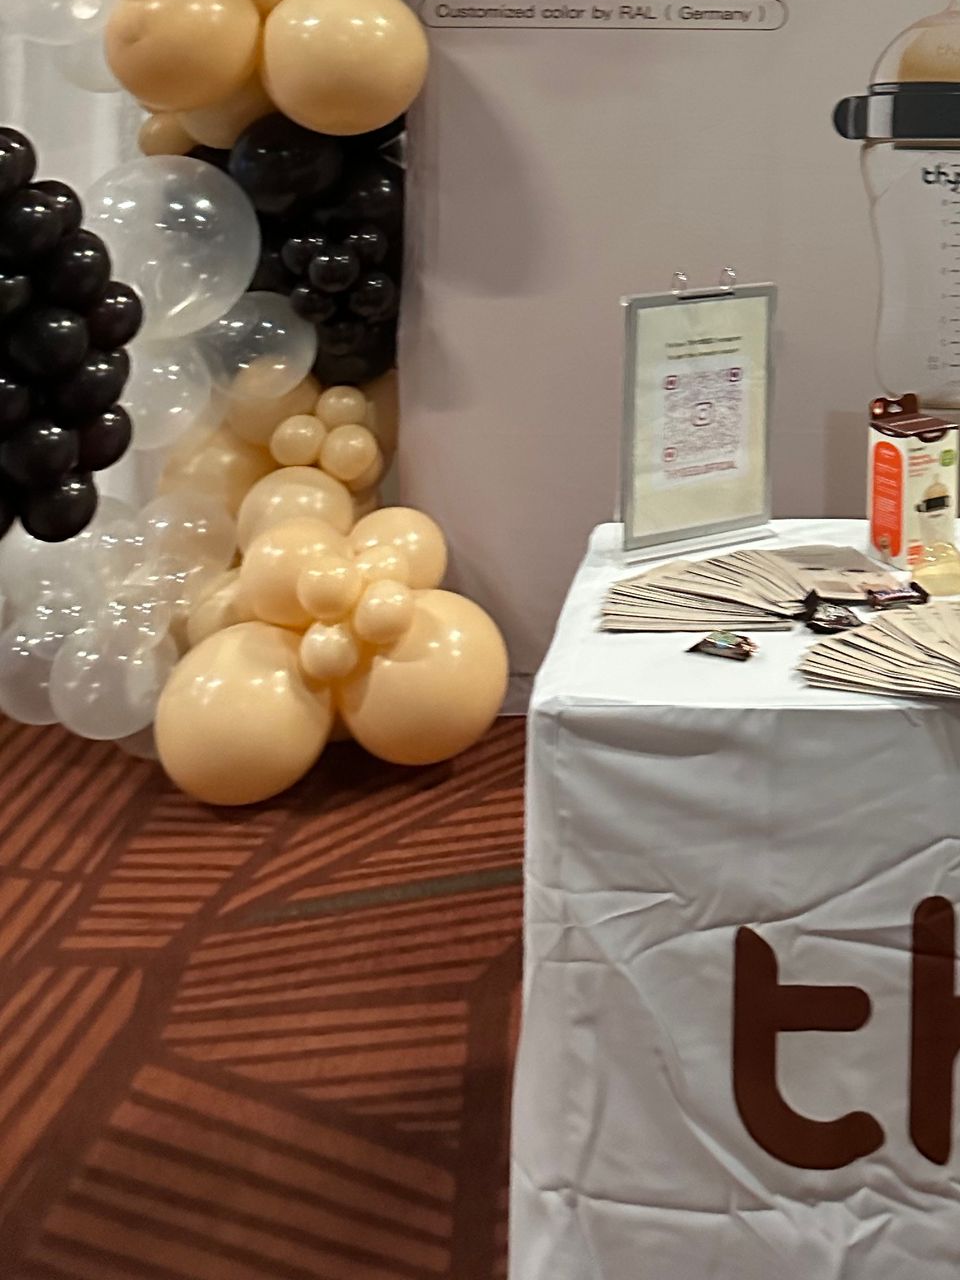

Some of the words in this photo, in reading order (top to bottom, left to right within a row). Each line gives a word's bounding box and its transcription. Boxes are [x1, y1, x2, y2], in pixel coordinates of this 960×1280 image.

[434, 3, 536, 19] Customized
[541, 4, 586, 20] color
[592, 5, 612, 21] by
[618, 6, 657, 21] RAL
